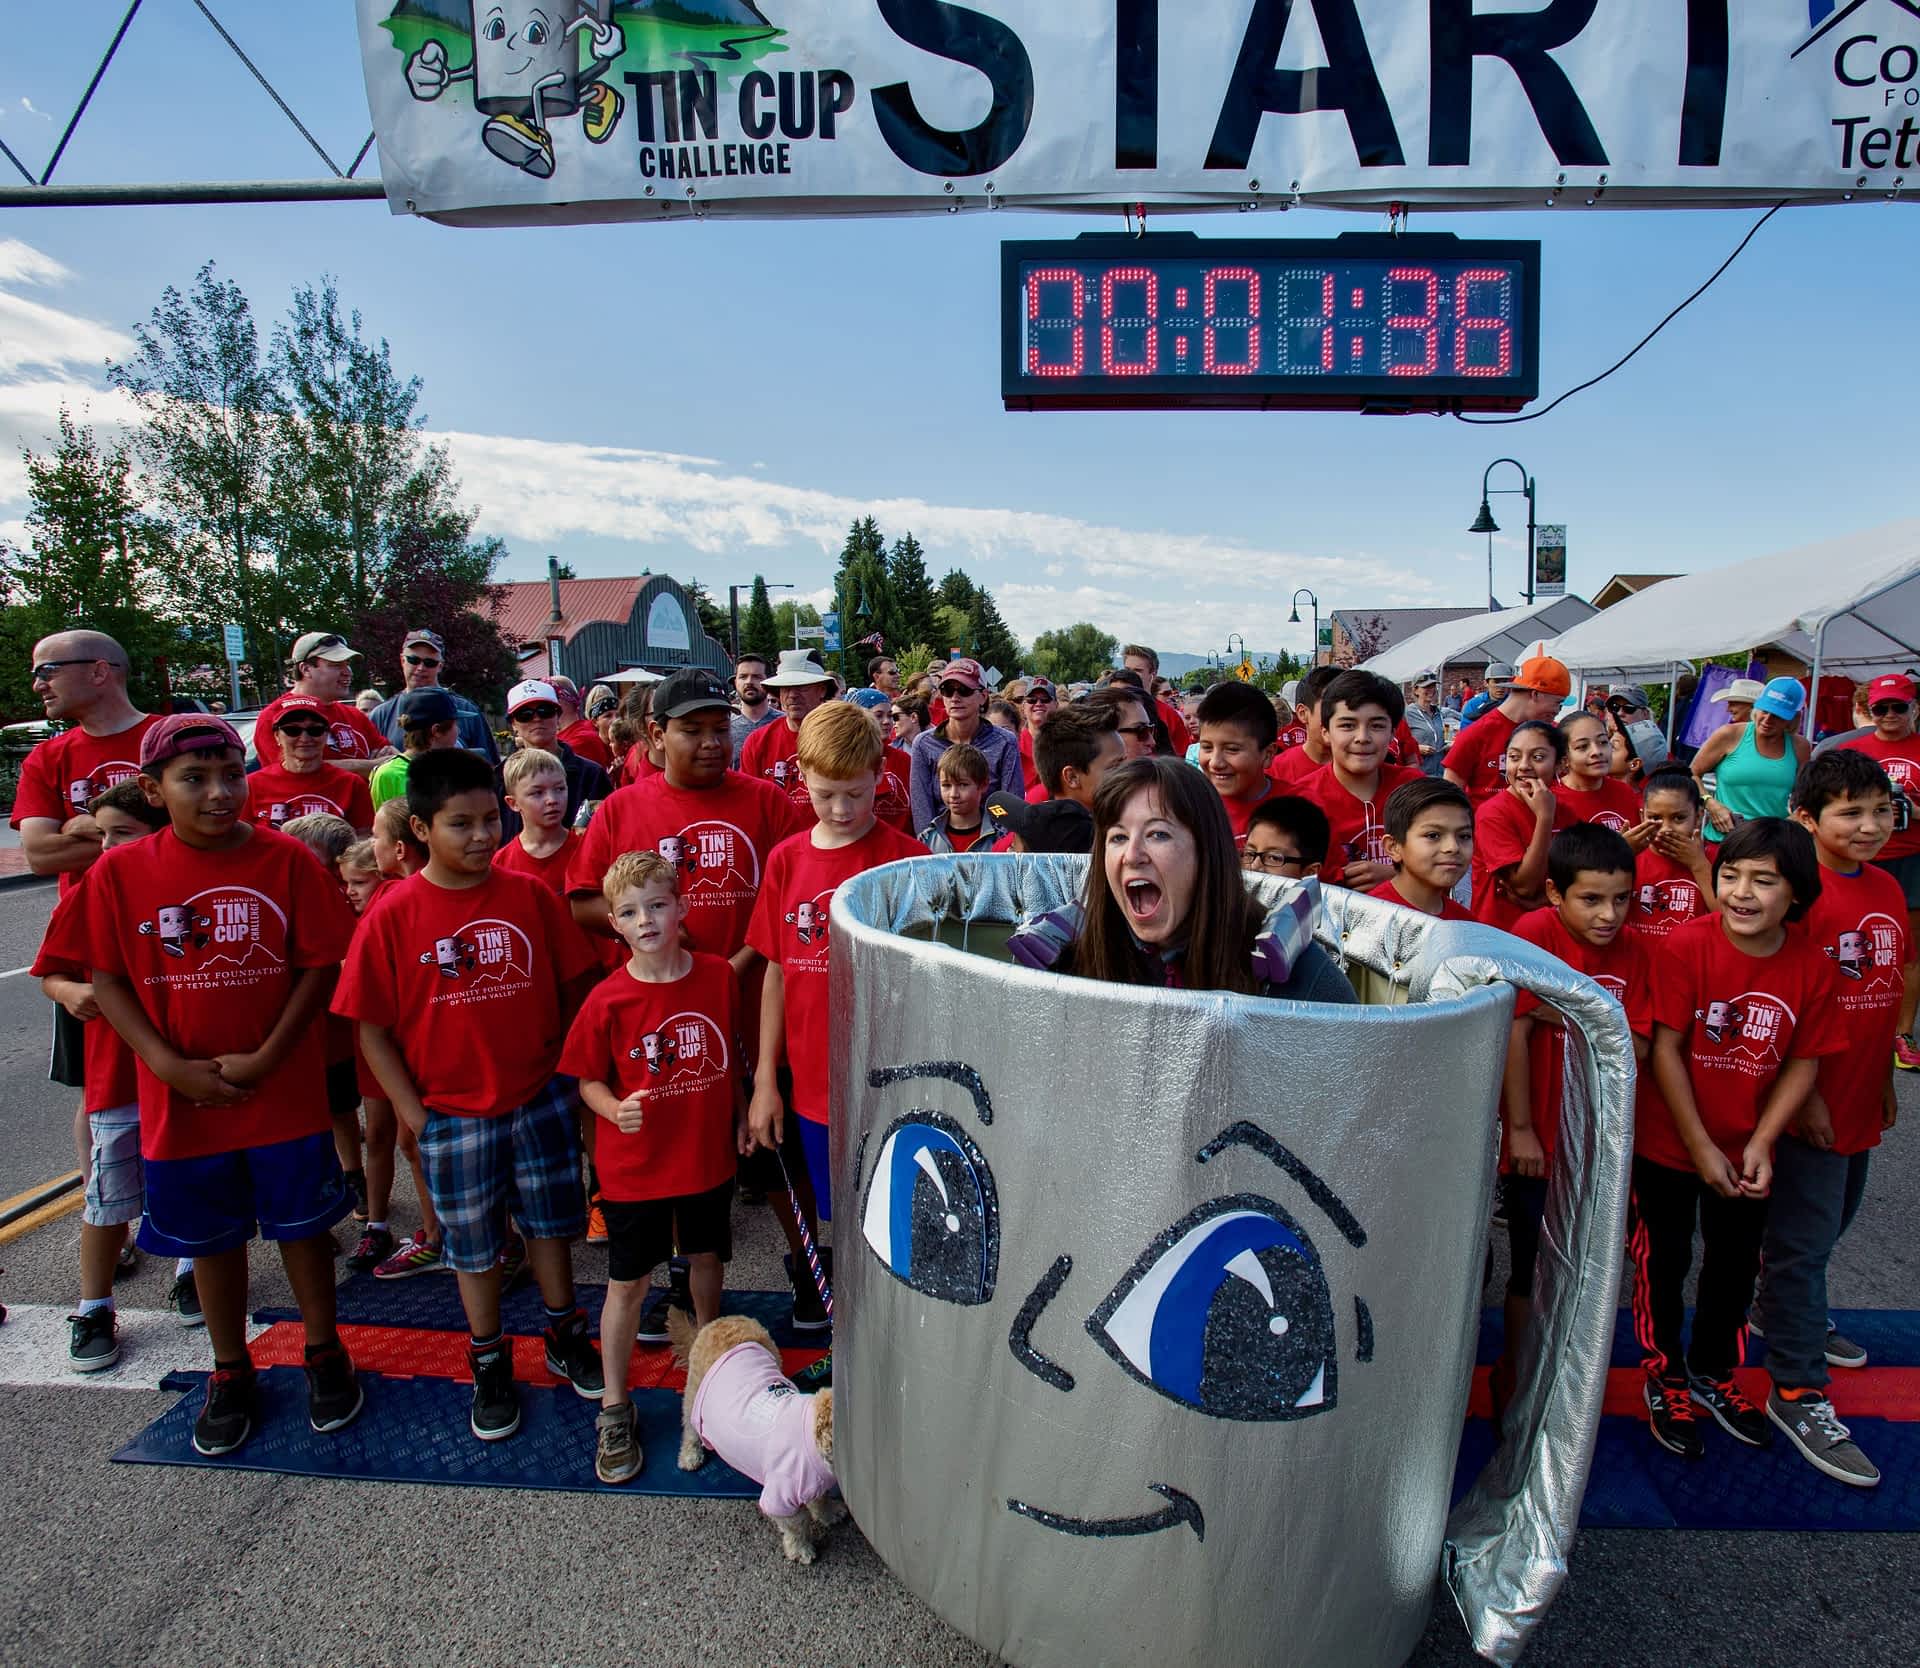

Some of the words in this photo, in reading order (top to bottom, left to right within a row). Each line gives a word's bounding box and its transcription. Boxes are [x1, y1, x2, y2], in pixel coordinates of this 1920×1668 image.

[624, 70, 718, 144] TIN
[738, 69, 855, 142] CUP
[1831, 116, 1920, 170] Tet
[639, 143, 791, 180] CHALLENGE
[698, 834, 726, 852] TIN
[700, 852, 726, 868] CUP
[1670, 888, 1689, 900] TIN
[213, 903, 249, 925] TIN
[1669, 900, 1688, 911] CUP
[214, 924, 249, 943] CUP
[475, 931, 504, 949] TIN
[1872, 929, 1892, 949] TIN
[479, 949, 504, 964] CUP
[1875, 949, 1892, 966] CUP
[144, 973, 211, 985] COMMUNITY
[186, 982, 219, 990] TETON
[223, 977, 261, 987] VALLEY
[462, 995, 487, 1004] TETON
[490, 990, 516, 999] VALLEY
[1747, 1005, 1775, 1027] TIN
[676, 1025, 700, 1045] TIN
[1742, 1023, 1771, 1041] CUP
[679, 1042, 701, 1059] CUP
[686, 1083, 711, 1093] VALLEY
